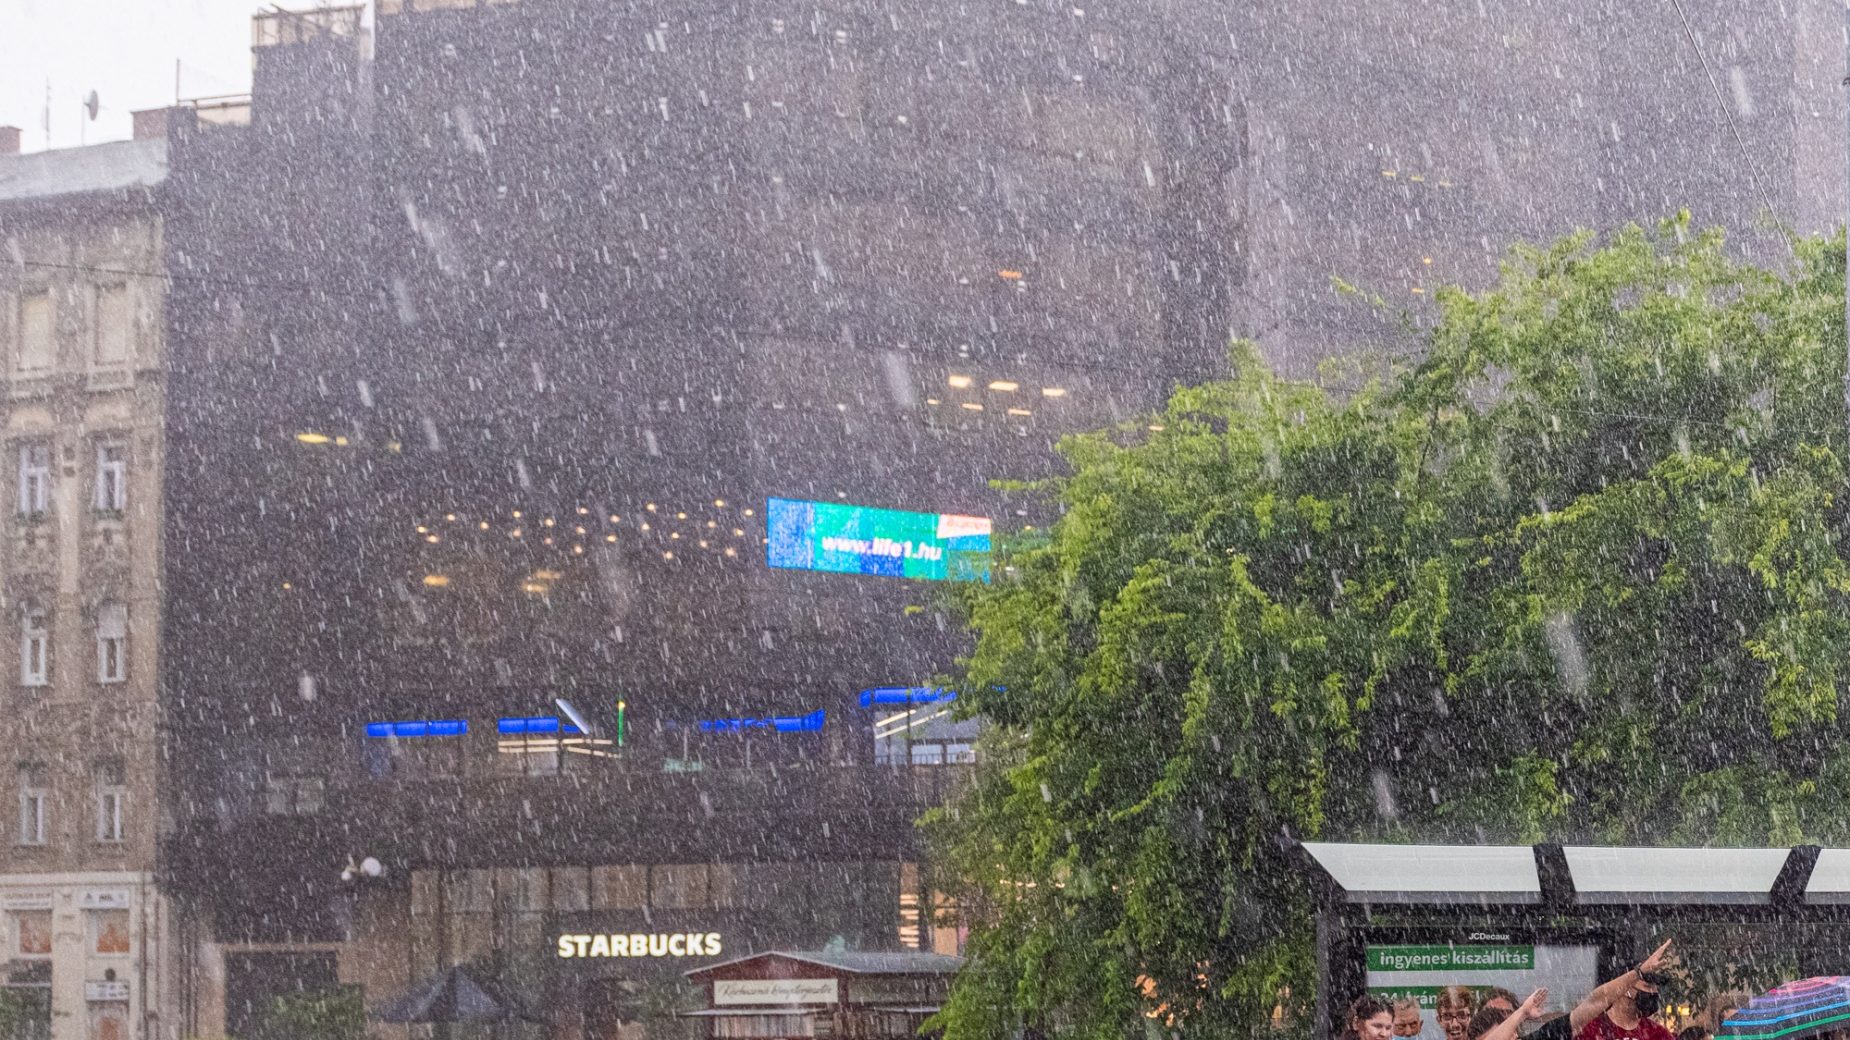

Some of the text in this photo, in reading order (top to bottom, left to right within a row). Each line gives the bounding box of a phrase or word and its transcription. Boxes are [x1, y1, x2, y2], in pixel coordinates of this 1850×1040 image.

[558, 932, 722, 958] STARBUCKS
[1468, 932, 1510, 941] JCDecaux
[1380, 951, 1529, 969] ingyenes kiszállítás
